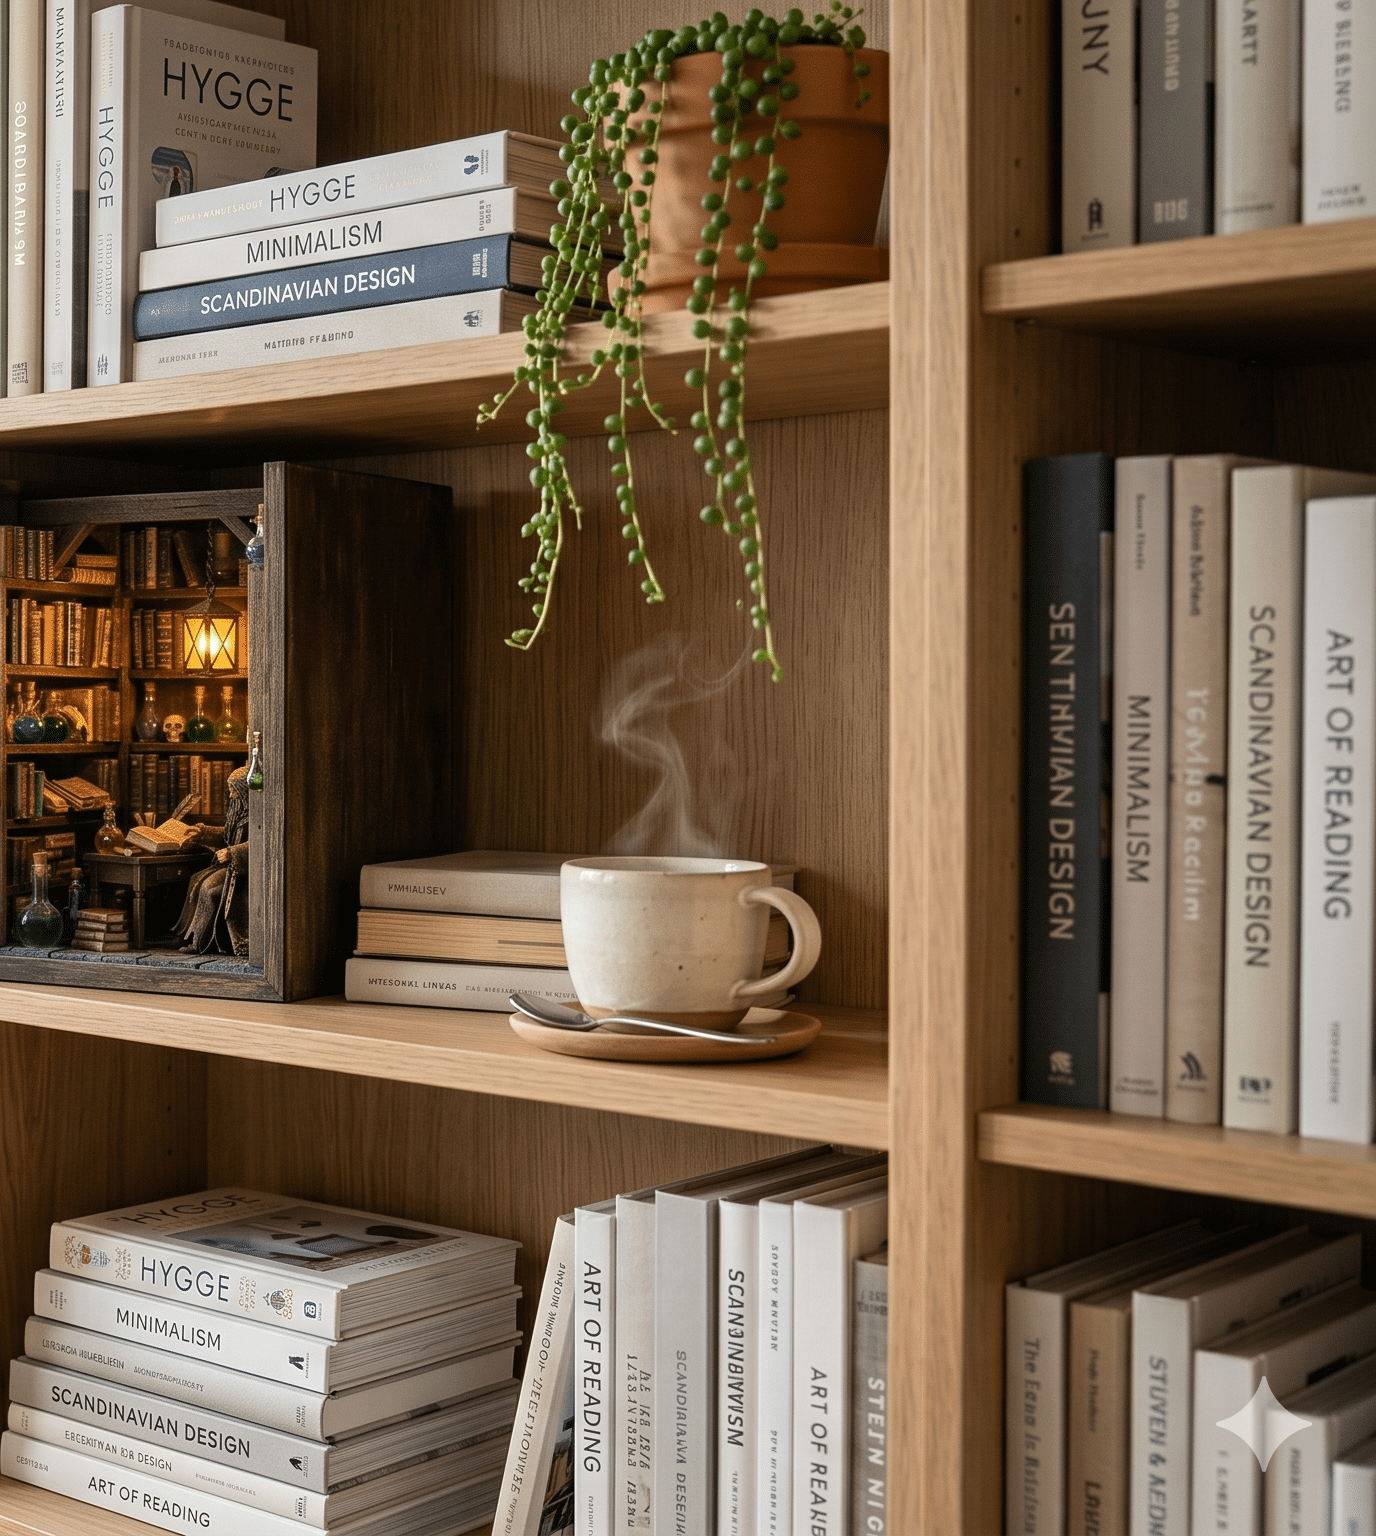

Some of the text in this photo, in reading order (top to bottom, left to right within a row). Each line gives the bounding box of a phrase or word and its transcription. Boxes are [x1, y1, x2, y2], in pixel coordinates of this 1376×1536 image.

[163, 57, 293, 122] HYGGE
[99, 106, 115, 209] HYGGE
[270, 174, 356, 213] HYGGE
[247, 220, 382, 265] MINIMALISM
[200, 264, 415, 315] SCANDINAVIAN DESIGN
[1049, 602, 1075, 667] SEN
[1126, 695, 1151, 884] MINIMALISM
[1244, 605, 1276, 968] SCANDINAVIAN DESIGN
[1324, 630, 1354, 920] ART OF READING
[1048, 818, 1074, 940] DESIGN
[120, 1194, 261, 1225] HYGGE
[141, 1256, 230, 1303] HYGGE
[115, 1307, 222, 1352] MINIMALISM
[582, 1260, 602, 1473] ART OF READING
[810, 1366, 828, 1414] ART
[51, 1385, 251, 1459] SCANDINAVIAN DESIGN
[810, 1422, 828, 1455] OF
[137, 1452, 173, 1472] DESIGN
[88, 1476, 211, 1528] ART OF READING
